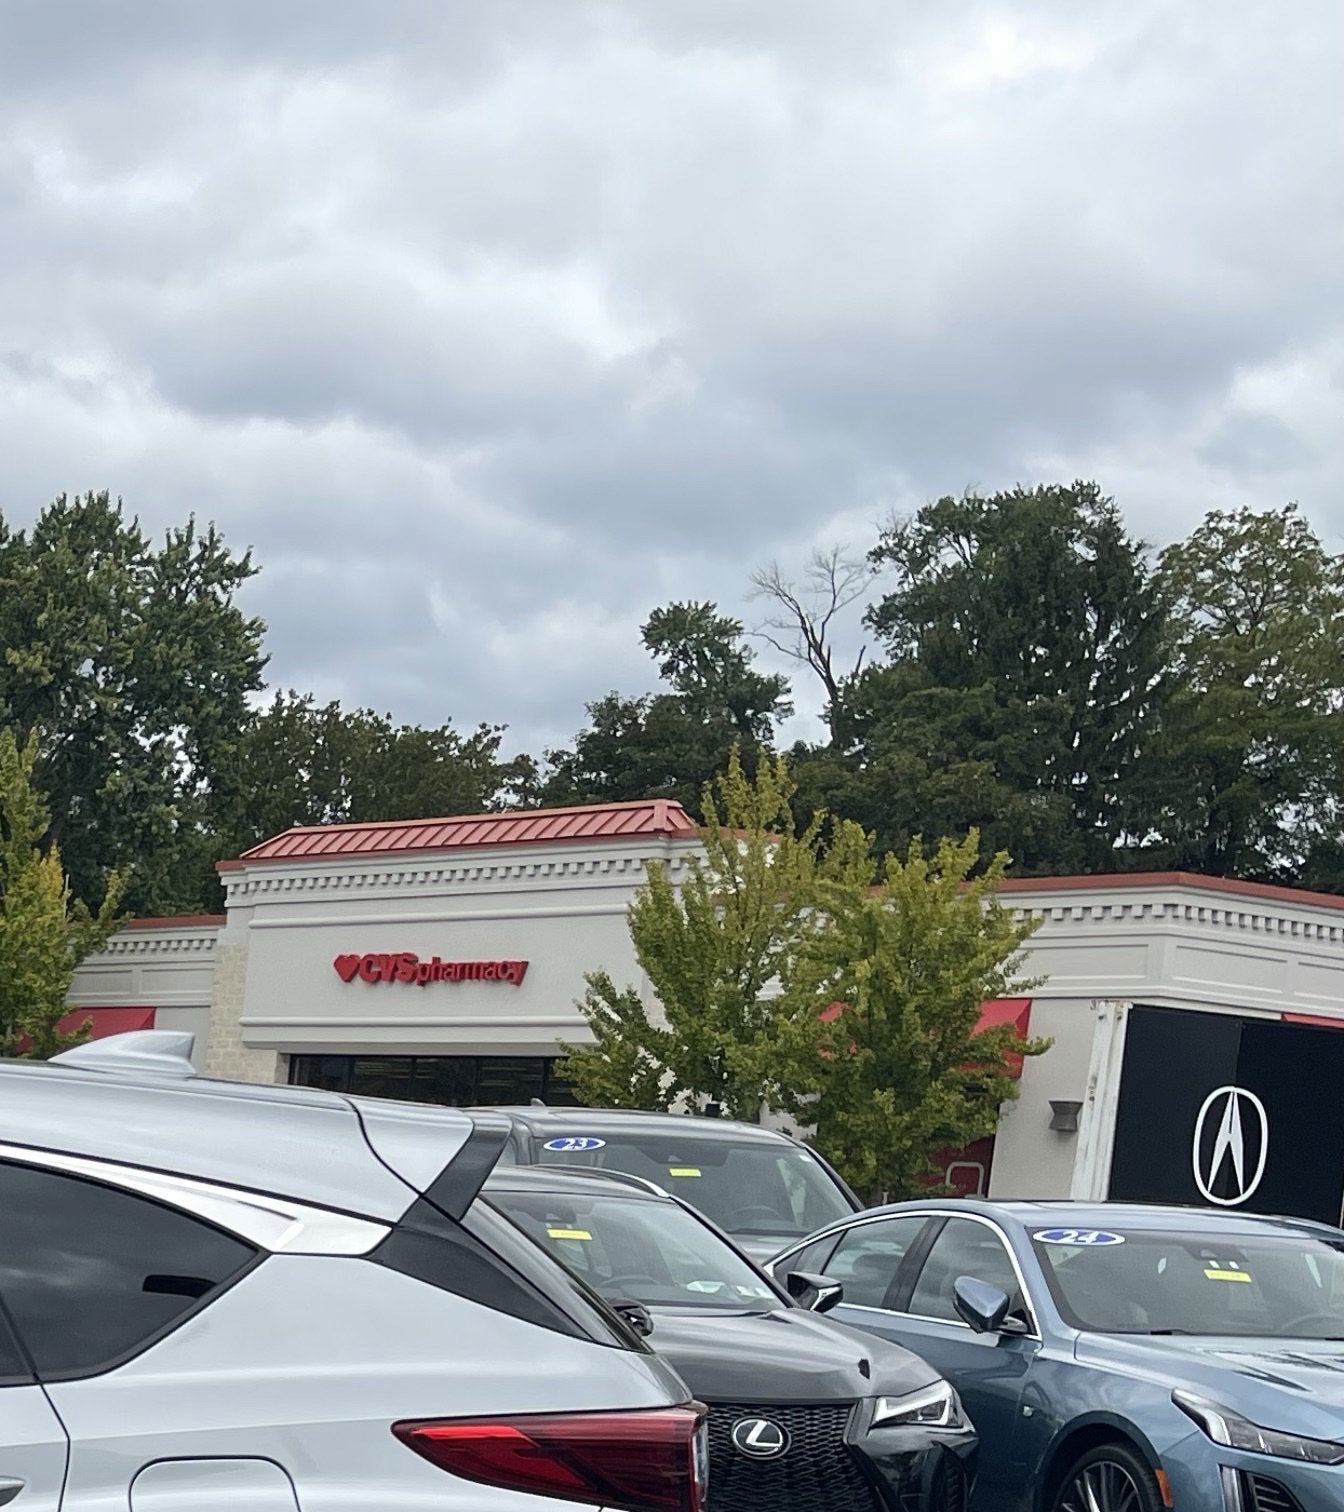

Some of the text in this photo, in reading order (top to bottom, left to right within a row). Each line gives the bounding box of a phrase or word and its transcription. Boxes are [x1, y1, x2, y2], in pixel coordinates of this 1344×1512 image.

[359, 952, 529, 987] CVS pharmacy
[562, 1137, 588, 1150] 23
[1058, 1230, 1099, 1244] 24
